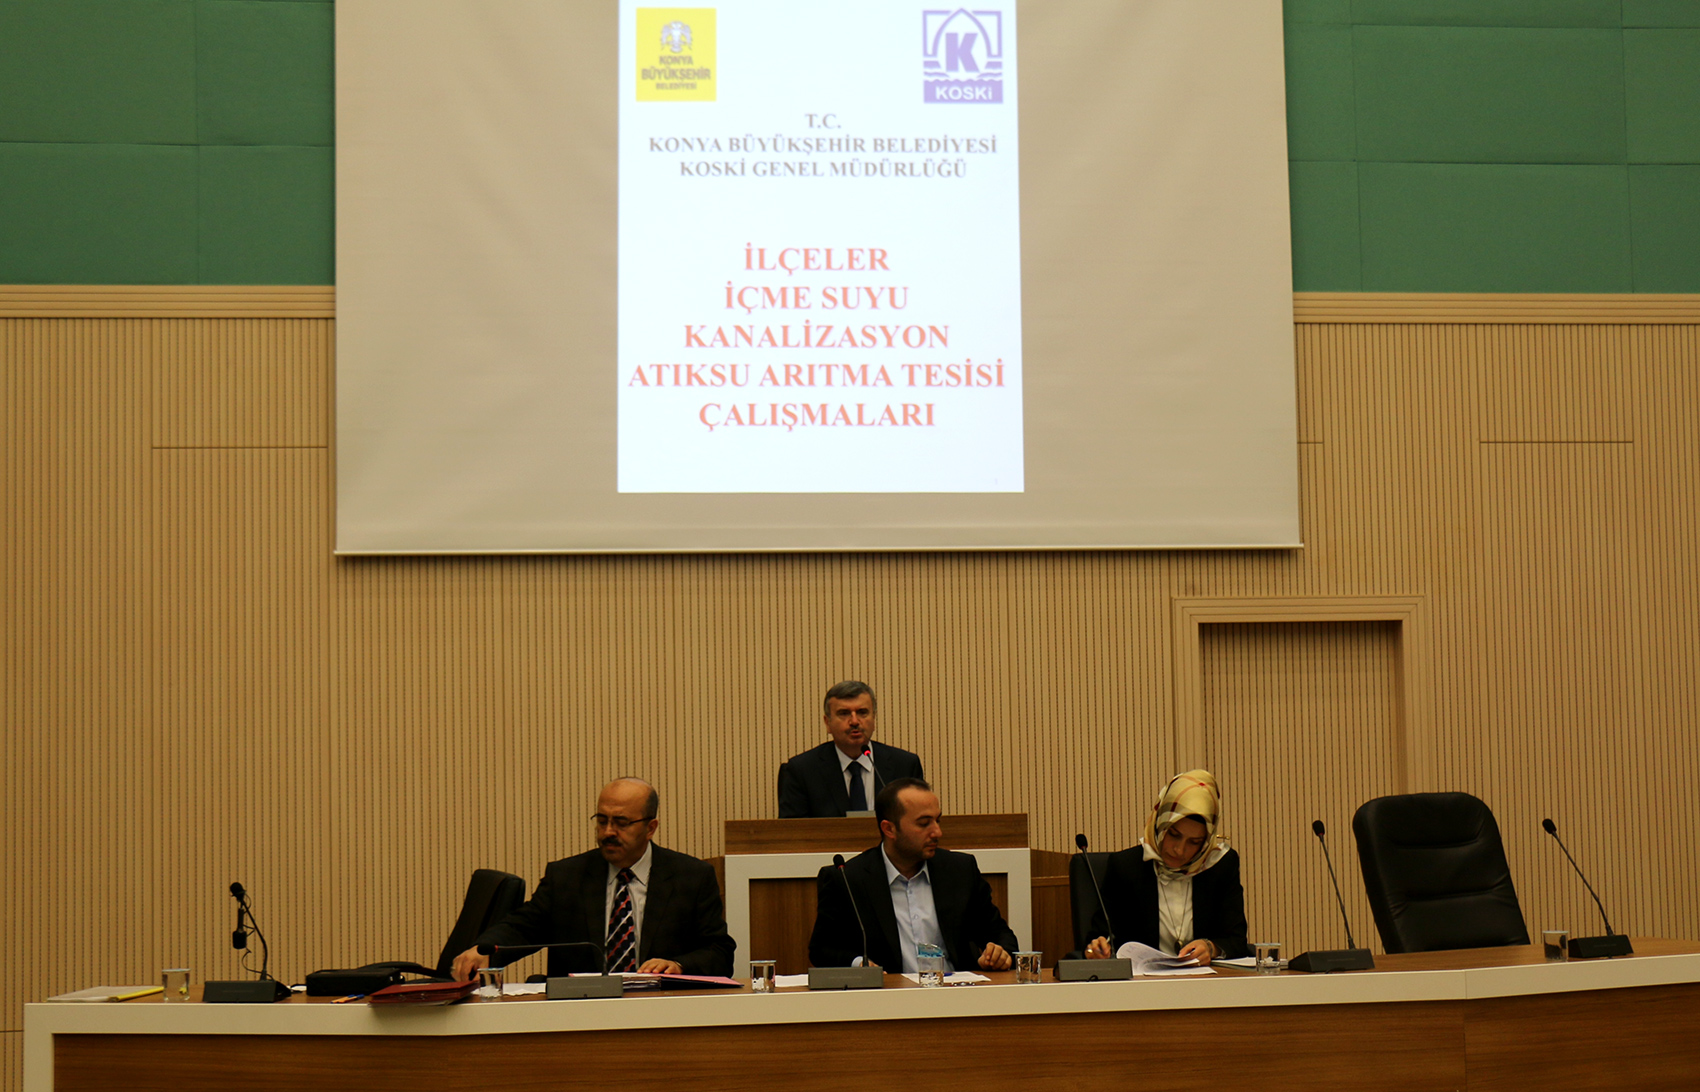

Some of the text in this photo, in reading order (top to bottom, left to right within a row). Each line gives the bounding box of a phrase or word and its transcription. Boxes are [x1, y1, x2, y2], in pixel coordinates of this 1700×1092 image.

[659, 55, 694, 65] KONYA
[945, 32, 979, 72] K
[805, 114, 842, 129] T.C.
[649, 134, 997, 156] KONYA BÜYÜKŞEHİR BELEDİYESİ
[680, 158, 967, 178] KOSKİ GENEL MÜDÜRLÜĞÜ
[744, 242, 891, 275] İLÇELER
[724, 280, 909, 314] İÇME SUYU
[684, 319, 950, 349] KANALİZASYON
[628, 358, 1006, 388] ATIKSU ARITMA TESİSİ
[698, 402, 936, 433] ÇALIŞMALARI
